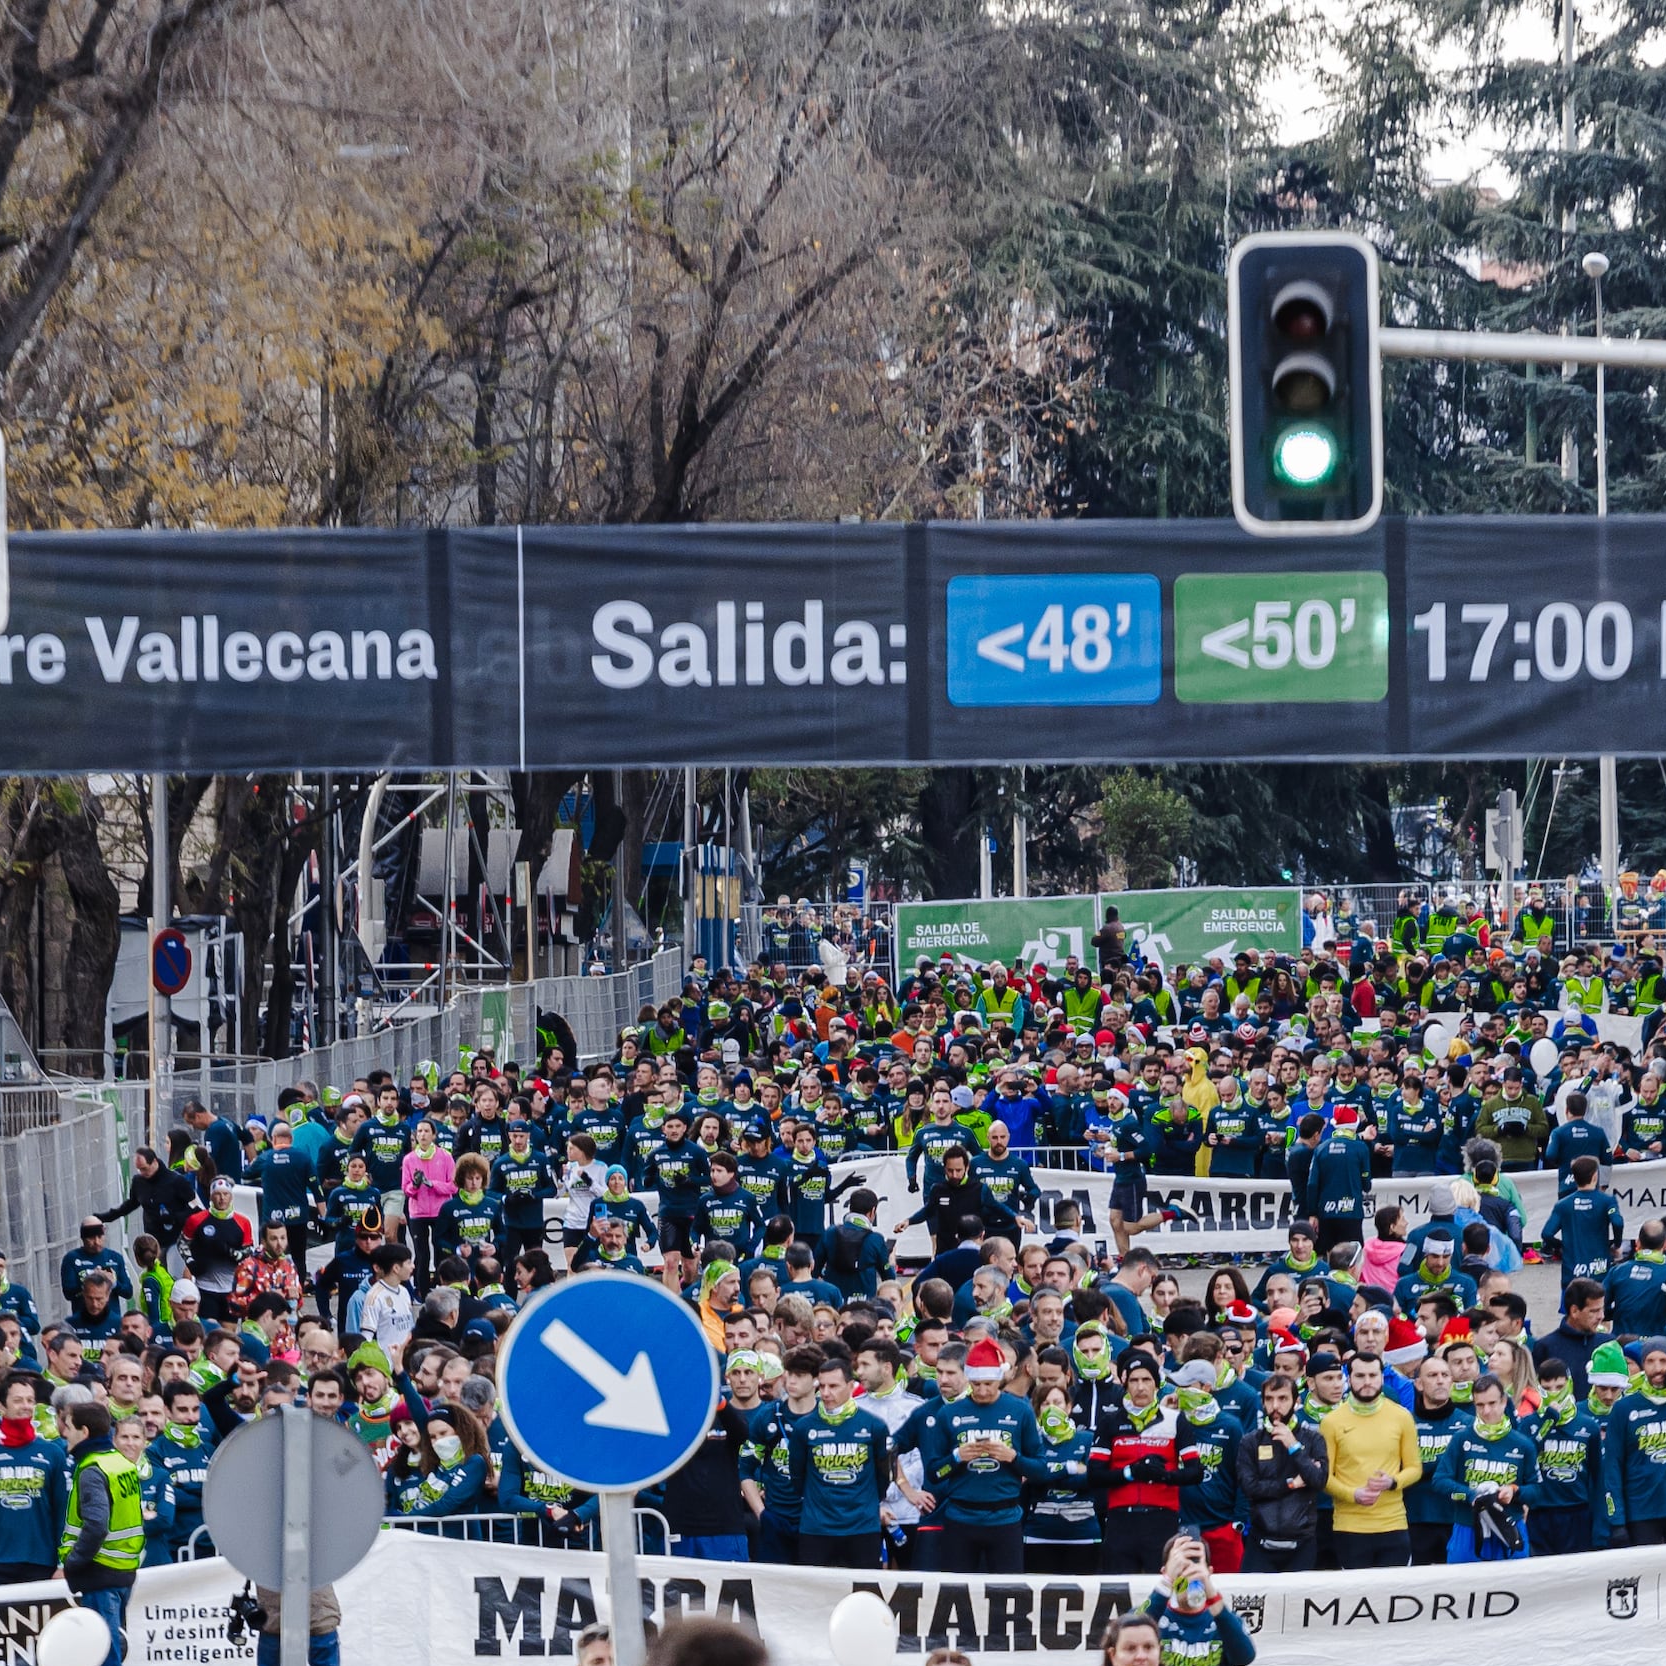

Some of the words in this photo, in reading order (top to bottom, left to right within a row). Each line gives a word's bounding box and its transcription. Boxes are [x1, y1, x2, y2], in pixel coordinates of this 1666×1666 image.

[589, 599, 908, 688] Salida:
[1413, 600, 1631, 682] 17:00
[85, 615, 438, 684] Vallecana
[1211, 909, 1256, 921] SALIDA
[1259, 909, 1277, 921] DE
[915, 922, 961, 936] SALIDA
[963, 921, 980, 933] DE
[1203, 921, 1286, 933] EMERGENCIA
[908, 934, 989, 948] EMERGENCIA
[822, 1442, 838, 1456] NO
[838, 1442, 858, 1456] HAY
[813, 1452, 869, 1469] EXCUSAS
[1474, 1459, 1489, 1472] NO
[1488, 1461, 1510, 1474] HAY
[144, 1605, 232, 1622] Limpieza
[1303, 1590, 1521, 1628] MADRID
[145, 1631, 156, 1645] y
[145, 1644, 255, 1665] inteligente
